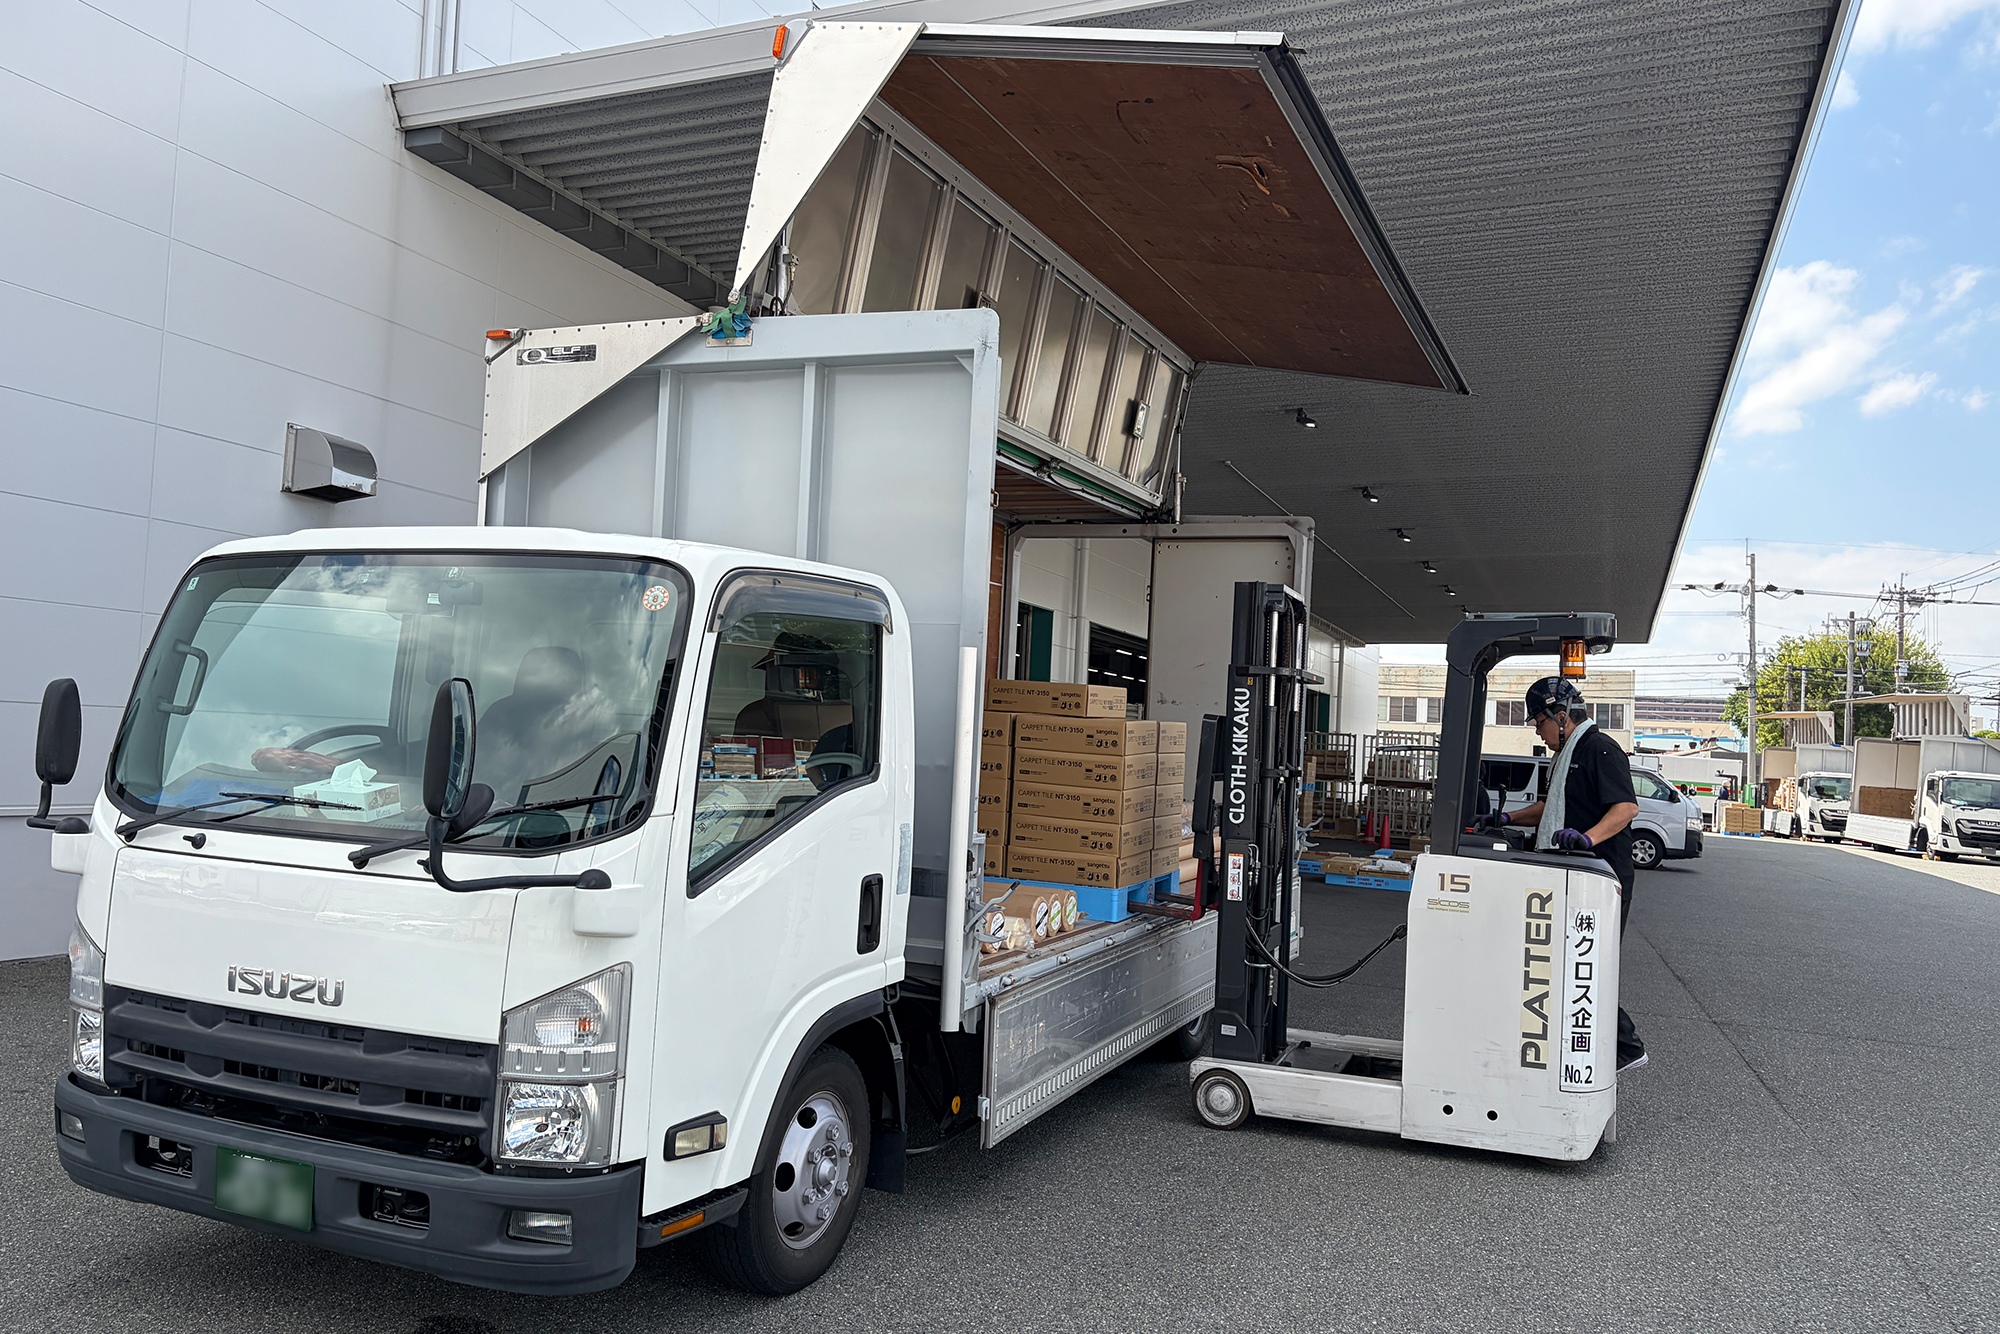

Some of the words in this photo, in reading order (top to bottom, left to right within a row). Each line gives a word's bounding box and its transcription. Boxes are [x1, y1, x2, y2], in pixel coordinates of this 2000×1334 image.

[552, 346, 581, 355] ELF
[652, 595, 659, 603] 8
[1021, 723, 1043, 731] CARPET
[1058, 726, 1085, 734] NT-3150
[1228, 687, 1251, 825] CLOTH-KIKAKU
[1044, 758, 1056, 766] TILE
[1056, 760, 1083, 768] NT-3150
[1018, 789, 1040, 798] CARPET
[1042, 791, 1054, 799] TILE
[1055, 793, 1081, 801] NT-3150
[1016, 822, 1038, 831] CARPET
[1040, 824, 1052, 832] TILE
[1053, 826, 1079, 835] NT-3150
[1090, 830, 1114, 838] sangetsu
[1012, 854, 1034, 862] CARPET
[1049, 858, 1076, 867] NT-3150
[1438, 873, 1470, 893] 15
[228, 964, 344, 1007] ISUZU
[1521, 891, 1553, 1070] PLATTER
